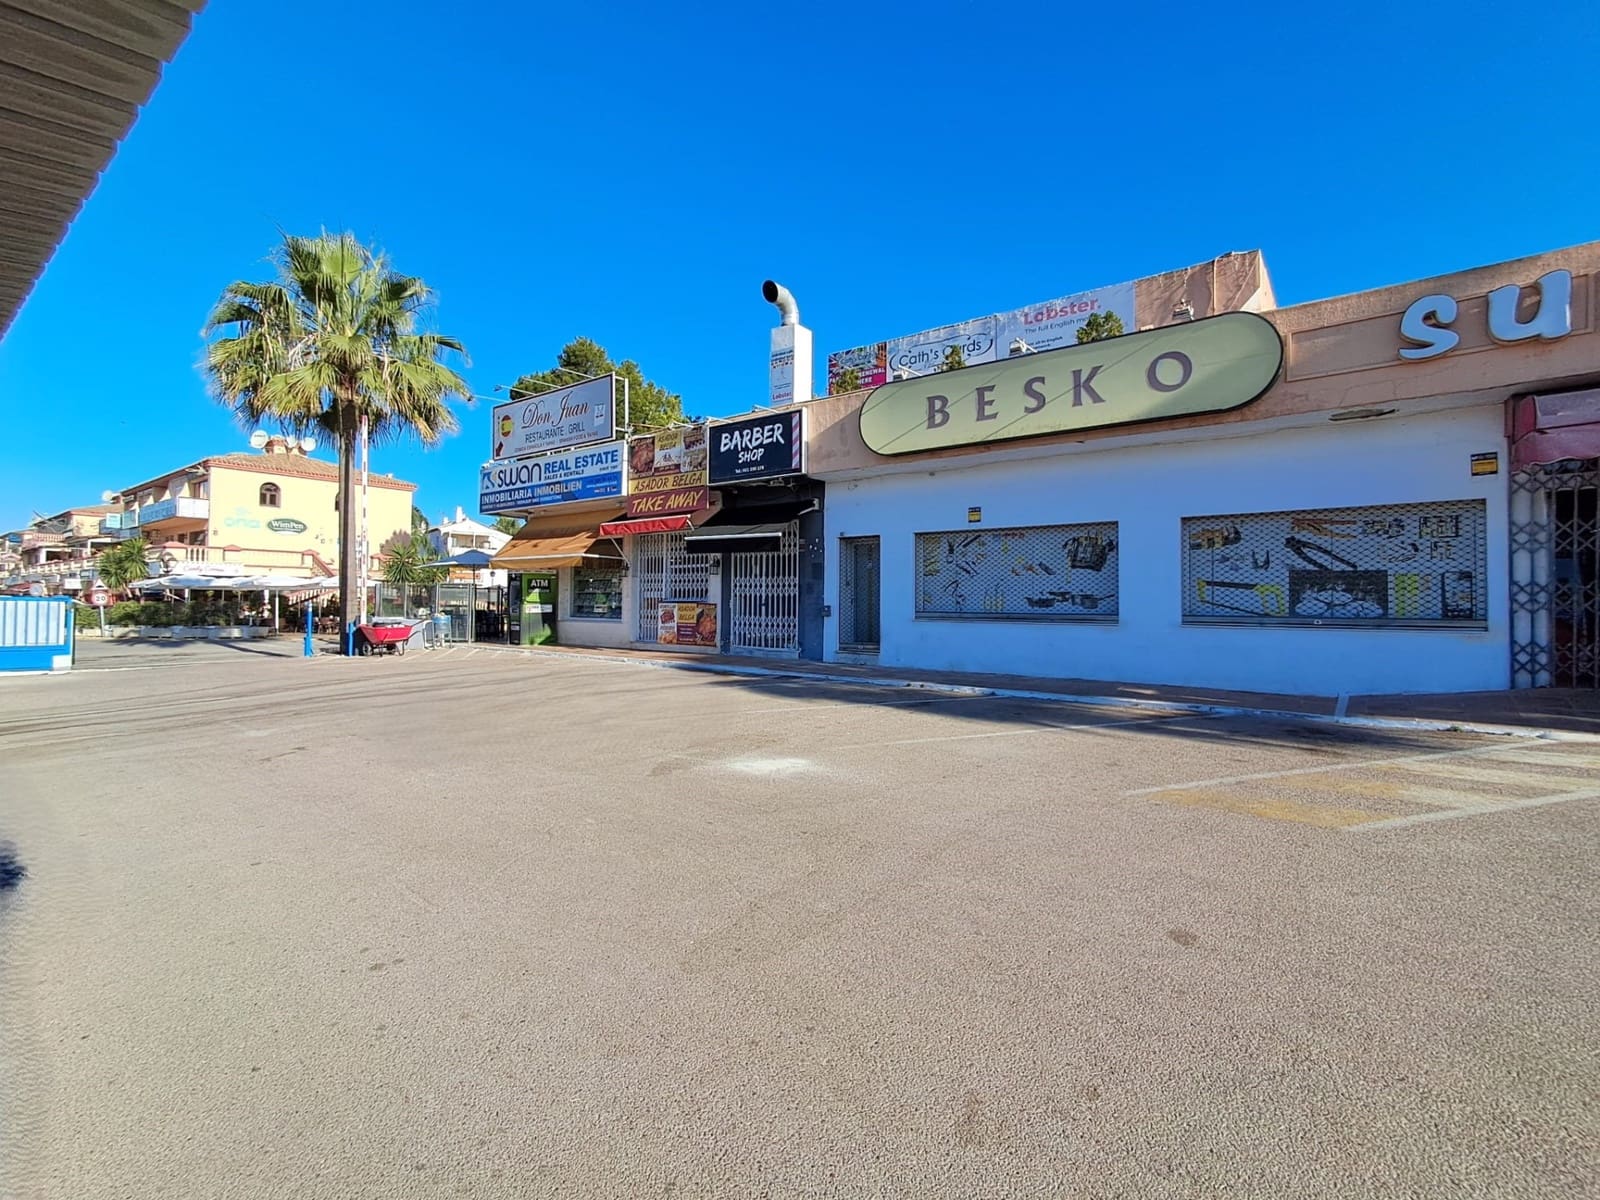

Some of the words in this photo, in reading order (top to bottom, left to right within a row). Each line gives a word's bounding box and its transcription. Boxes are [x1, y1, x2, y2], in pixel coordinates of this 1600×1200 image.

[1050, 319, 1075, 330] English
[1399, 268, 1572, 361] su
[899, 348, 939, 367] Cath's
[943, 339, 982, 358] Crds
[521, 400, 551, 430] Don
[551, 390, 590, 427] Juan
[525, 425, 565, 444] RESTAURANTE
[568, 421, 585, 435] GRILL
[720, 423, 785, 453] BARBER
[544, 460, 572, 474] REAL
[574, 450, 619, 469] ESTATE
[738, 447, 765, 464] SHOP
[564, 469, 584, 478] RENTALS
[633, 478, 669, 493] ASADOR
[671, 472, 702, 487] BELGA
[481, 488, 533, 504] INMOBILIARIA
[533, 481, 583, 497] INMOBILIEN
[632, 495, 665, 513] TAKE
[665, 489, 704, 510] AWAY
[531, 579, 549, 588] ATM
